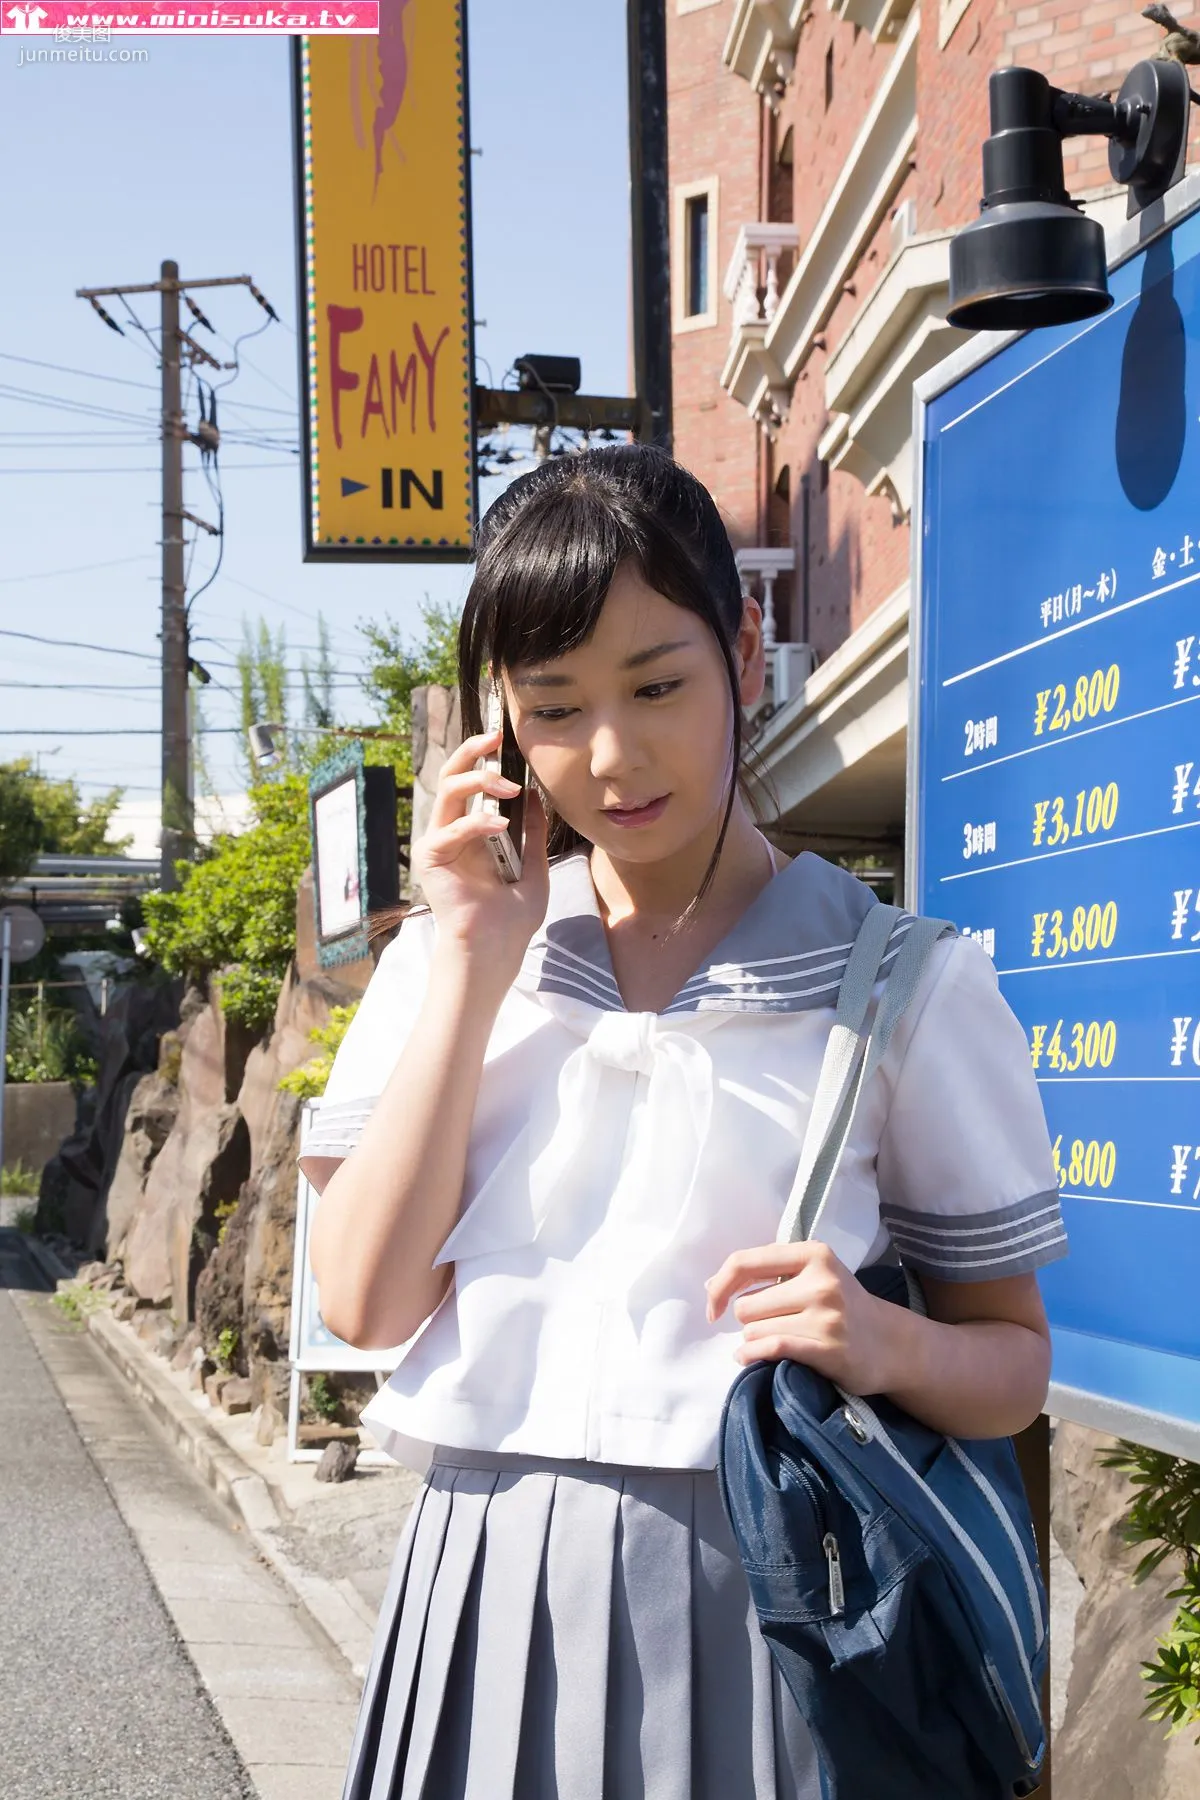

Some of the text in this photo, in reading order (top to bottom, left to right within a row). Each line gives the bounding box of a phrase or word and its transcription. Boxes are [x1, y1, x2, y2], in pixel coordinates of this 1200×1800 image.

[352, 243, 436, 296] HOTEL
[326, 303, 451, 450] FAMY
[381, 468, 443, 510] IN
[964, 715, 998, 756] 2時間
[1033, 663, 1120, 736] ¥2,800
[963, 821, 996, 859] 3時間
[1032, 782, 1119, 846] ¥3,100
[1031, 900, 1118, 959] ¥3,800
[1031, 1019, 1117, 1073] ¥4,300
